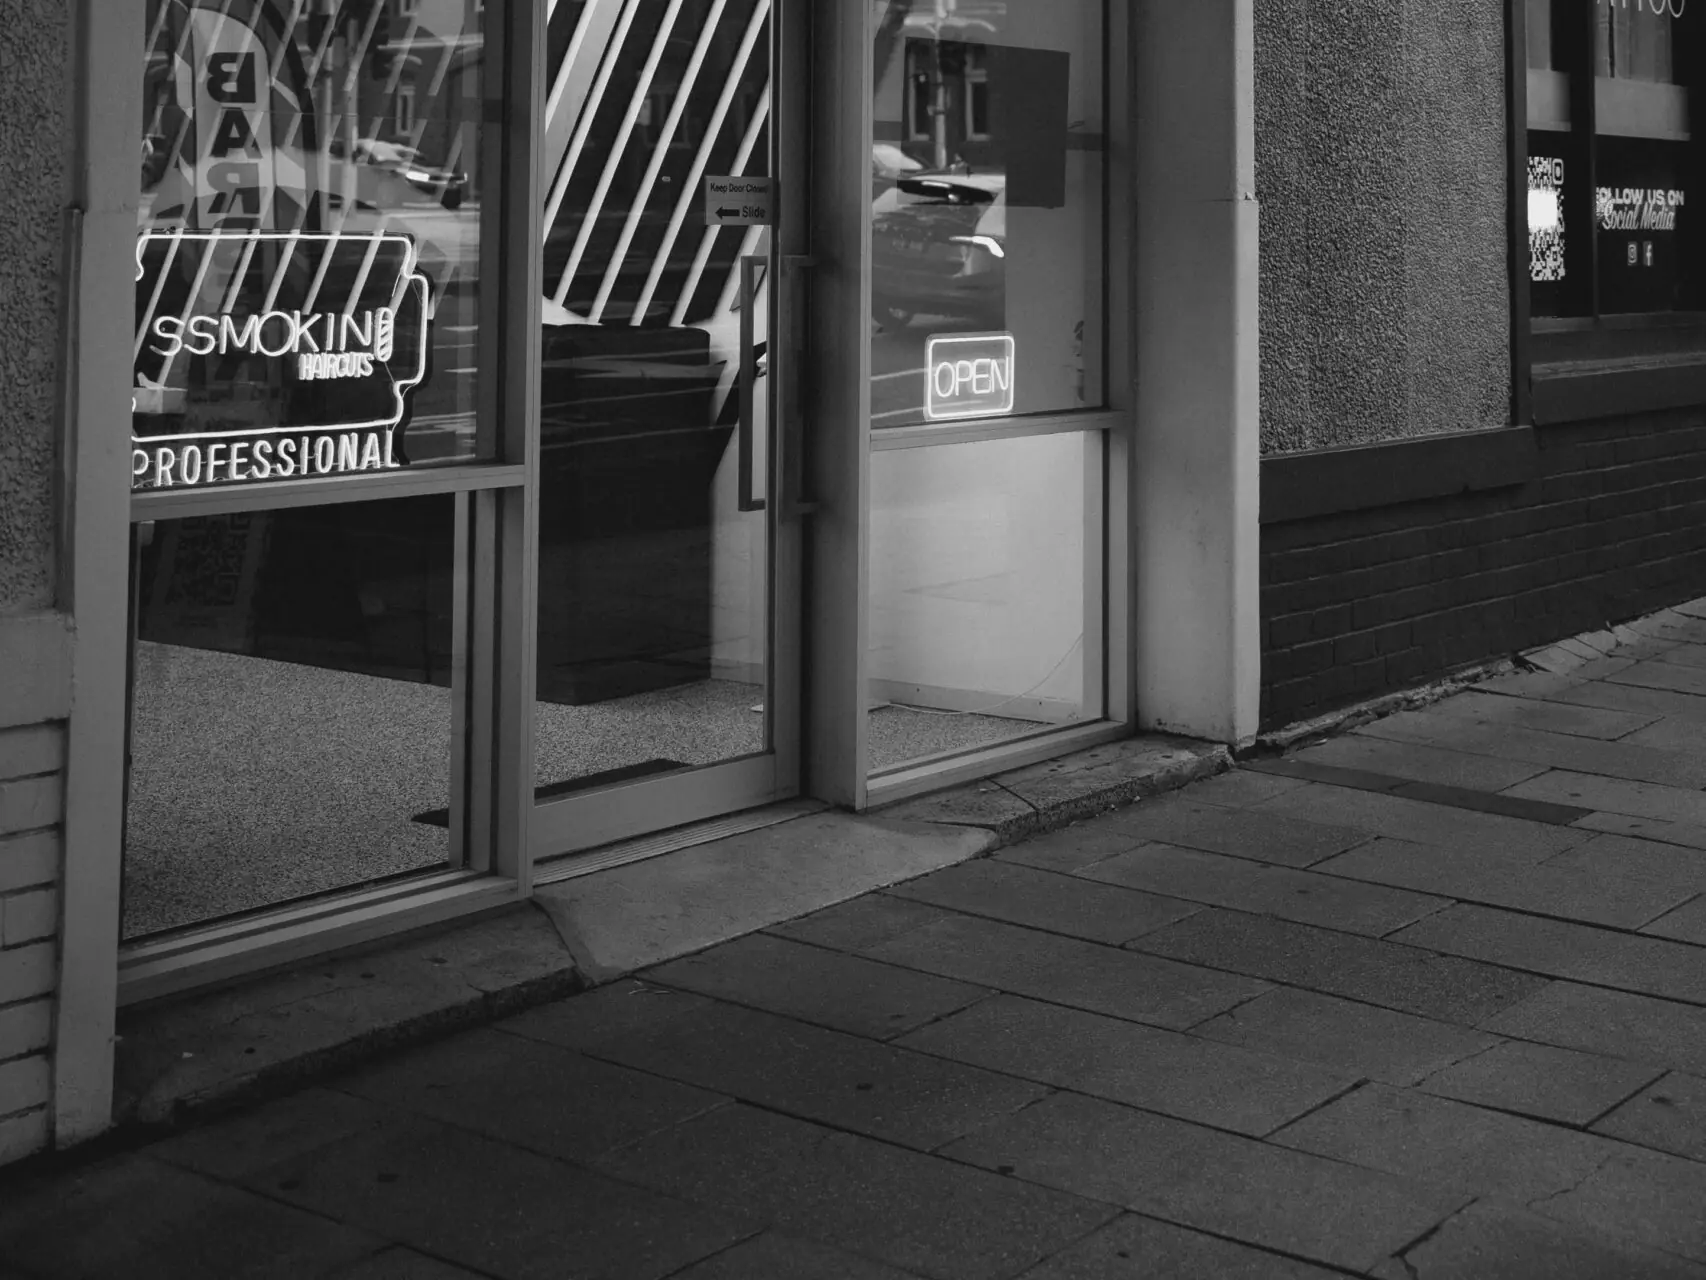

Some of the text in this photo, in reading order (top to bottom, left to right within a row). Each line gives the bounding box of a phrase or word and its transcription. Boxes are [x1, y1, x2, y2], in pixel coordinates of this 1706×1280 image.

[711, 182, 728, 195] Keep
[729, 183, 744, 193] Door
[1596, 187, 1684, 206] OLLOW US ON
[742, 206, 766, 219] Slide
[1602, 198, 1676, 231] Social Media
[299, 352, 374, 380] HAIRCUTS
[935, 356, 1009, 398] OPEN
